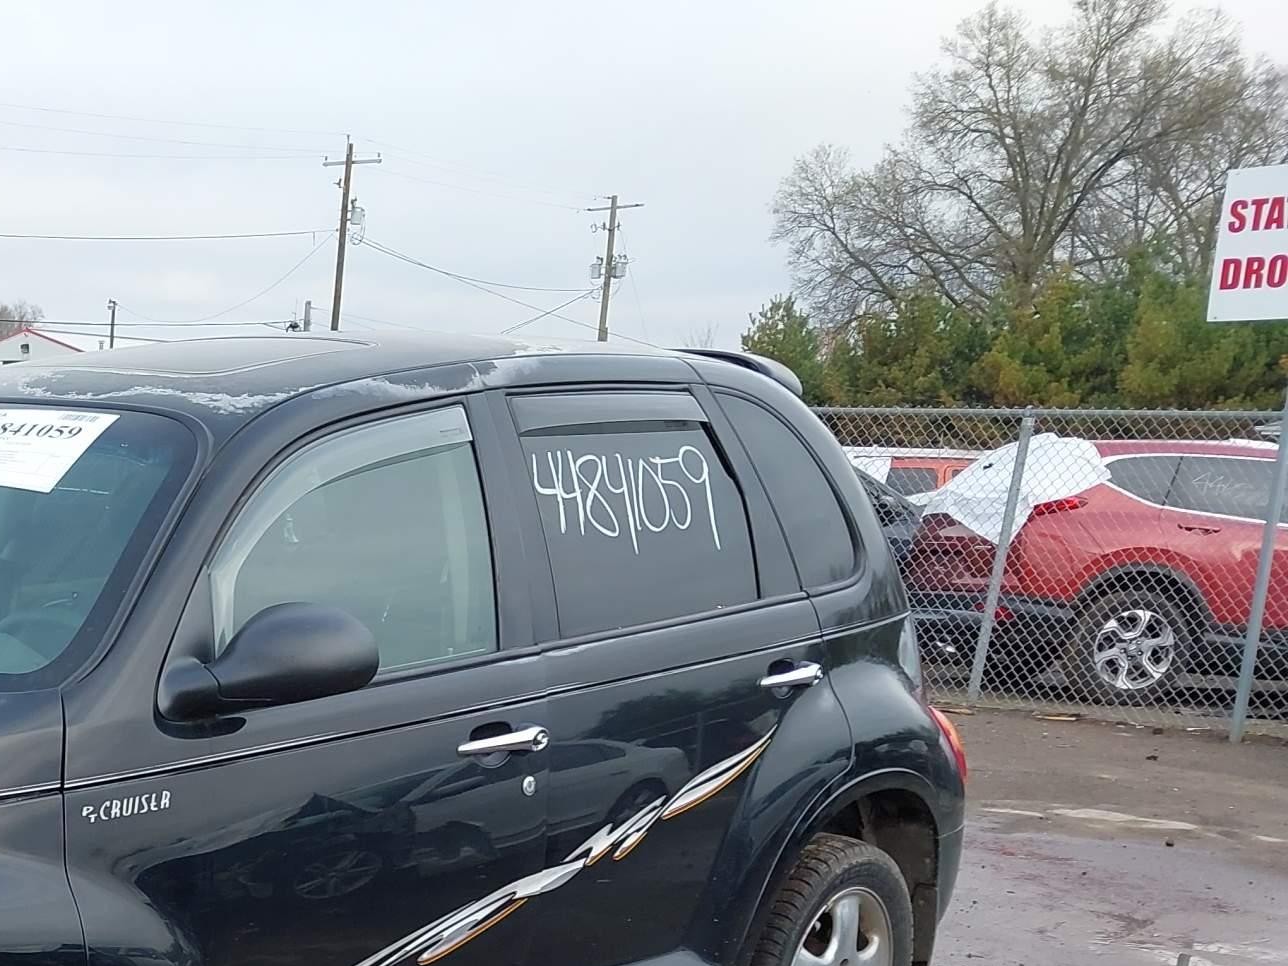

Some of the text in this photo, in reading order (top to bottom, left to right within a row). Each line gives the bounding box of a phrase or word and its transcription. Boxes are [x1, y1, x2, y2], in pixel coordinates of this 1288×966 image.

[1228, 196, 1288, 234] STA
[531, 445, 721, 555] 44841059
[99, 790, 171, 820] CRUISER
